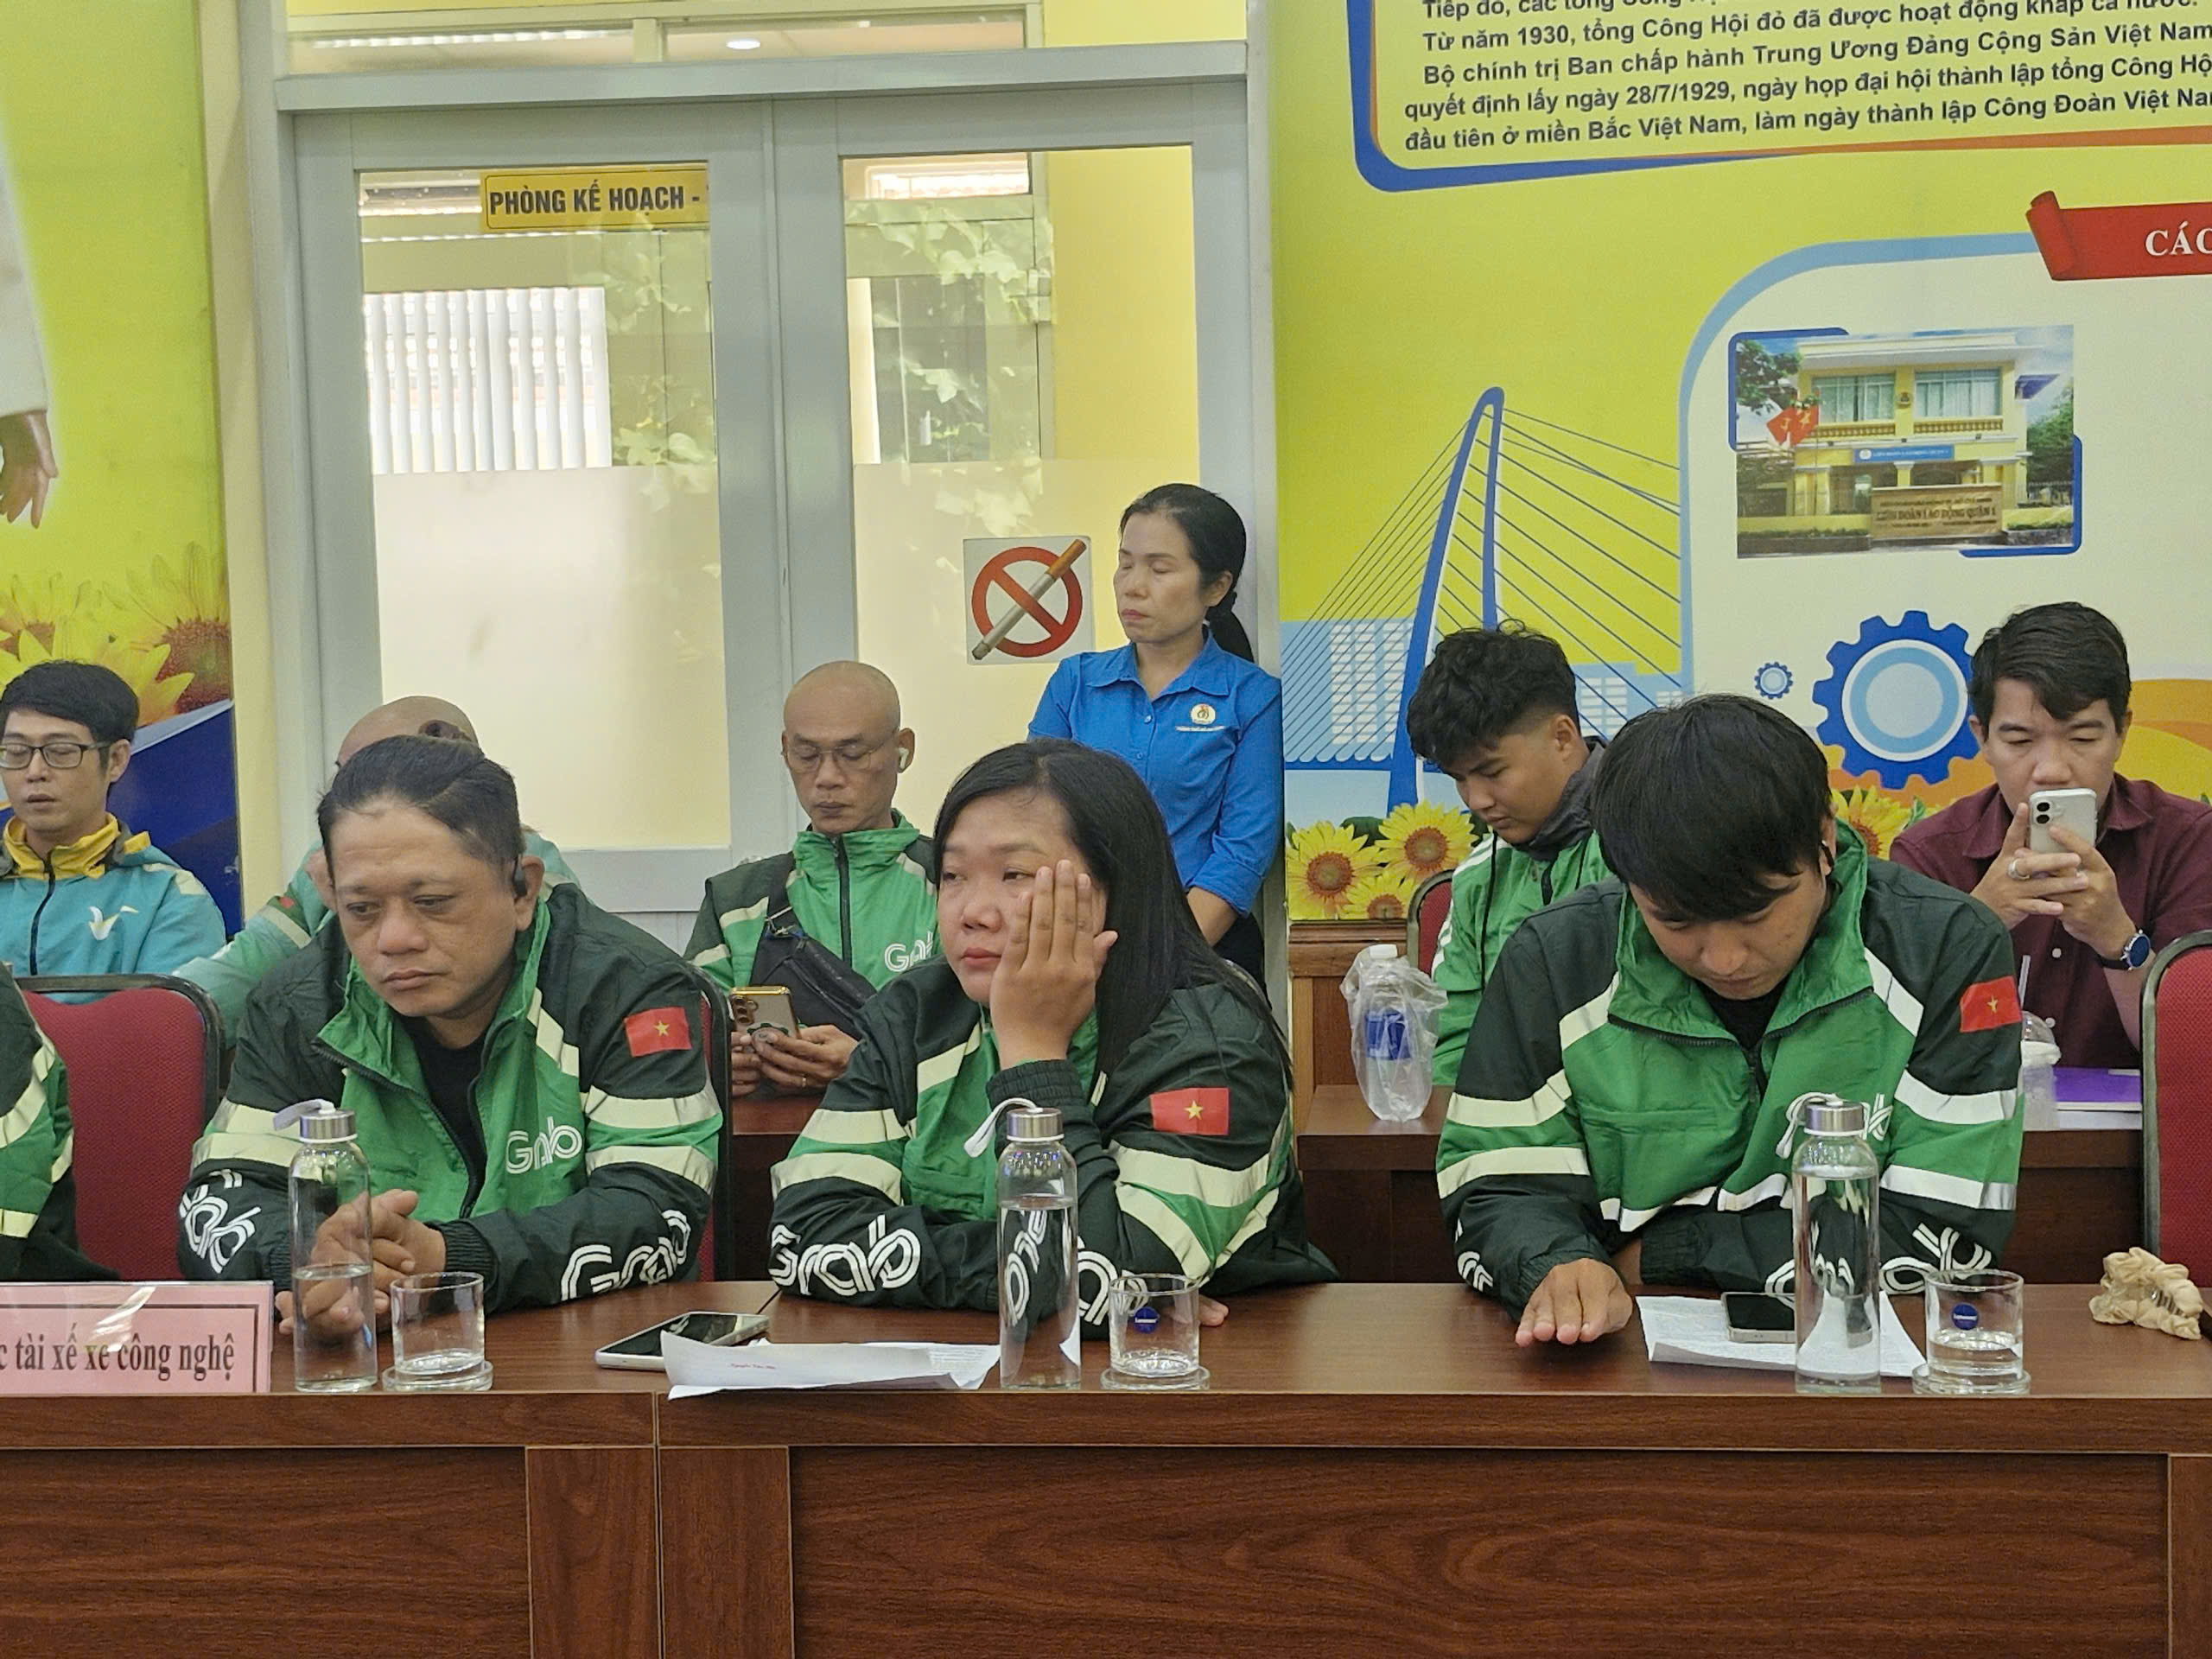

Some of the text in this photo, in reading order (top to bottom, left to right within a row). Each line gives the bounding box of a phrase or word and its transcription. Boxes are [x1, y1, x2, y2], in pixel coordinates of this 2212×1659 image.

[1423, 31, 1454, 51] Từ
[1462, 29, 1510, 49] năm
[1517, 24, 1576, 46] 1930,
[1583, 17, 1634, 43] tổng
[1643, 17, 1703, 40] Công
[1711, 13, 1748, 37] Hội
[1757, 10, 1785, 31] đỏ
[1793, 9, 1821, 29] đã
[1828, 7, 1891, 29] được
[1900, 3, 1951, 25] hoạt
[1959, 0, 2018, 22] động
[1424, 22, 2212, 87] Bộ chính trị Ban chấp hành Trung Ương Đảng Cộng Sản Việt Nam
[1405, 92, 1465, 122] quyết
[1472, 93, 1520, 118] định
[1528, 87, 1559, 114] lấy
[1566, 88, 1618, 112] ngày
[1626, 80, 1735, 105] 28/7/1929,
[1744, 77, 1797, 101] ngày
[1805, 75, 1847, 98] họp
[1855, 71, 1888, 95] đại
[1897, 69, 1930, 92] hội
[1938, 65, 2003, 86] thành
[2012, 63, 2044, 86] lập
[2051, 56, 2103, 83] tổng
[2111, 57, 2172, 79] Công
[1405, 87, 2212, 151] đầu tiên ở miền Bắc Việt Nam, làm ngày thành lập Công Đoàn Việt Na
[490, 185, 567, 215] PHÒNG
[574, 180, 602, 213] KẾ
[608, 186, 684, 216] HOẠCH
[2145, 220, 2212, 257] CÁC
[15, 1332, 45, 1370] tài
[51, 1323, 78, 1370] xế
[85, 1344, 110, 1370] xe
[118, 1332, 172, 1382] công
[179, 1332, 235, 1381] nghệ
